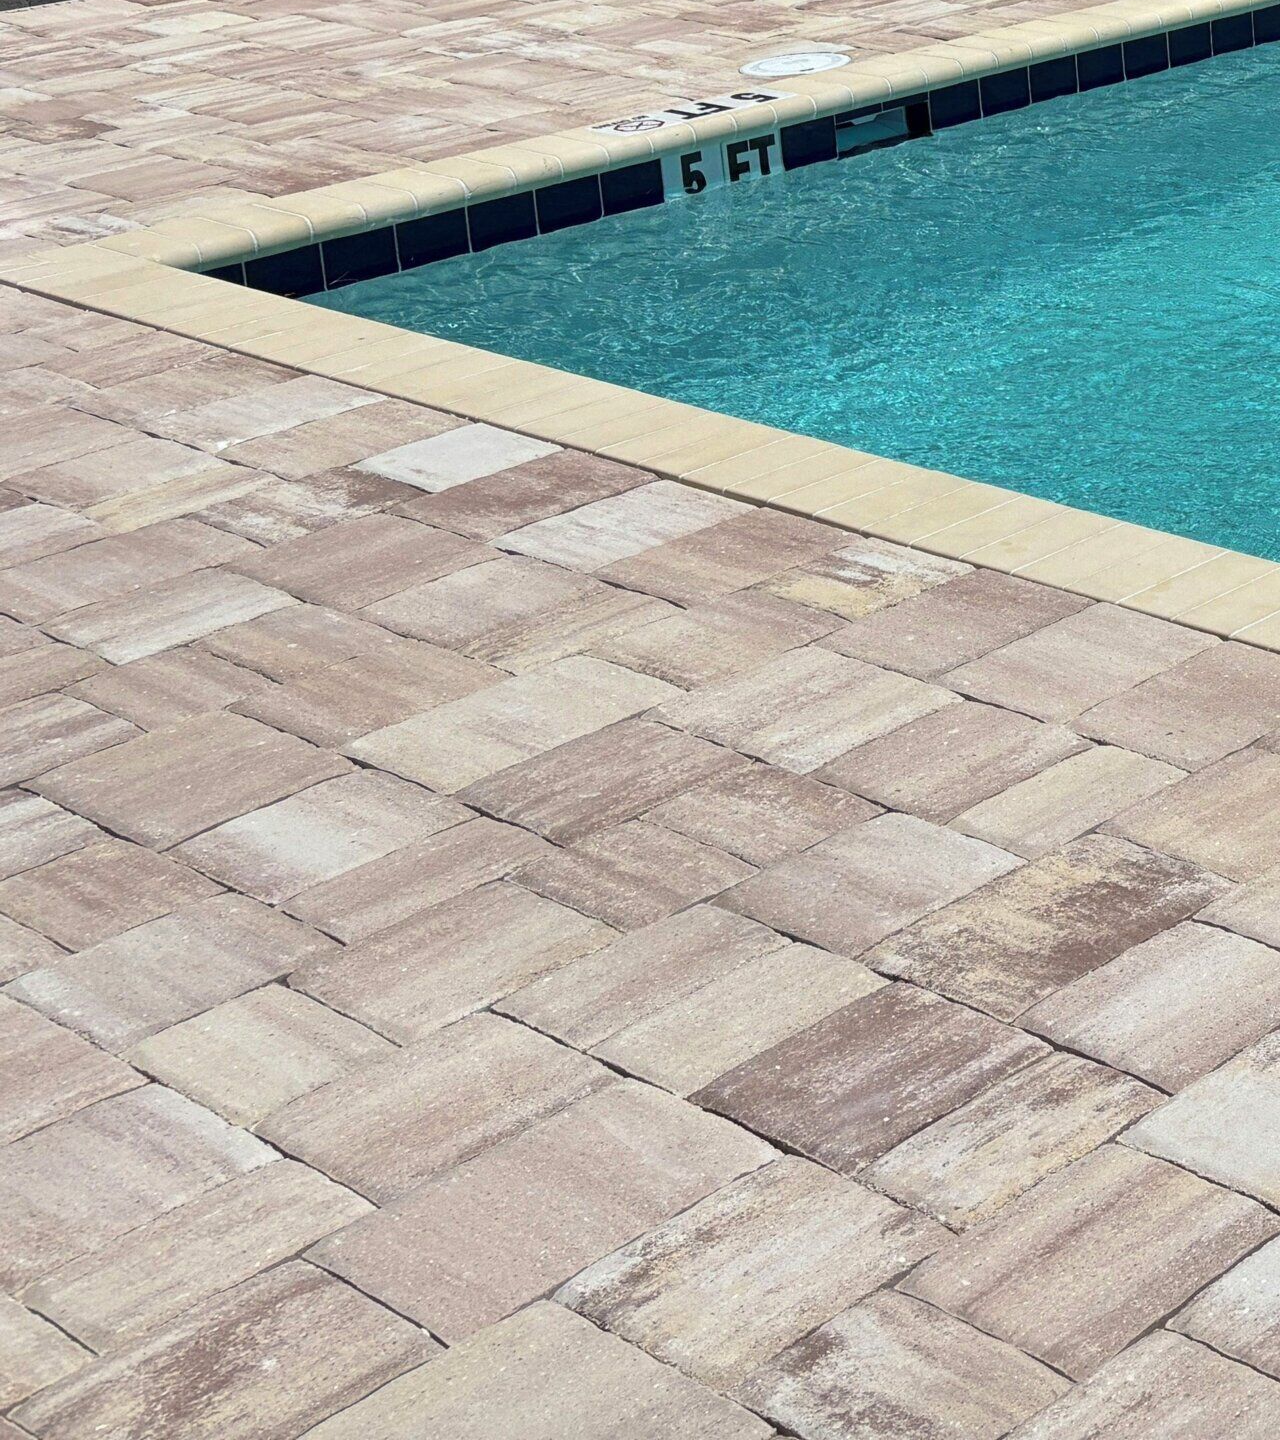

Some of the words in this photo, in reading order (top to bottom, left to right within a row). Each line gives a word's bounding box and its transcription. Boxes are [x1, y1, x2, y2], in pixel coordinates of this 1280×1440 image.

[731, 92, 778, 103] 5
[664, 102, 735, 120] FT
[680, 150, 707, 194] 5
[726, 133, 776, 182] FT
